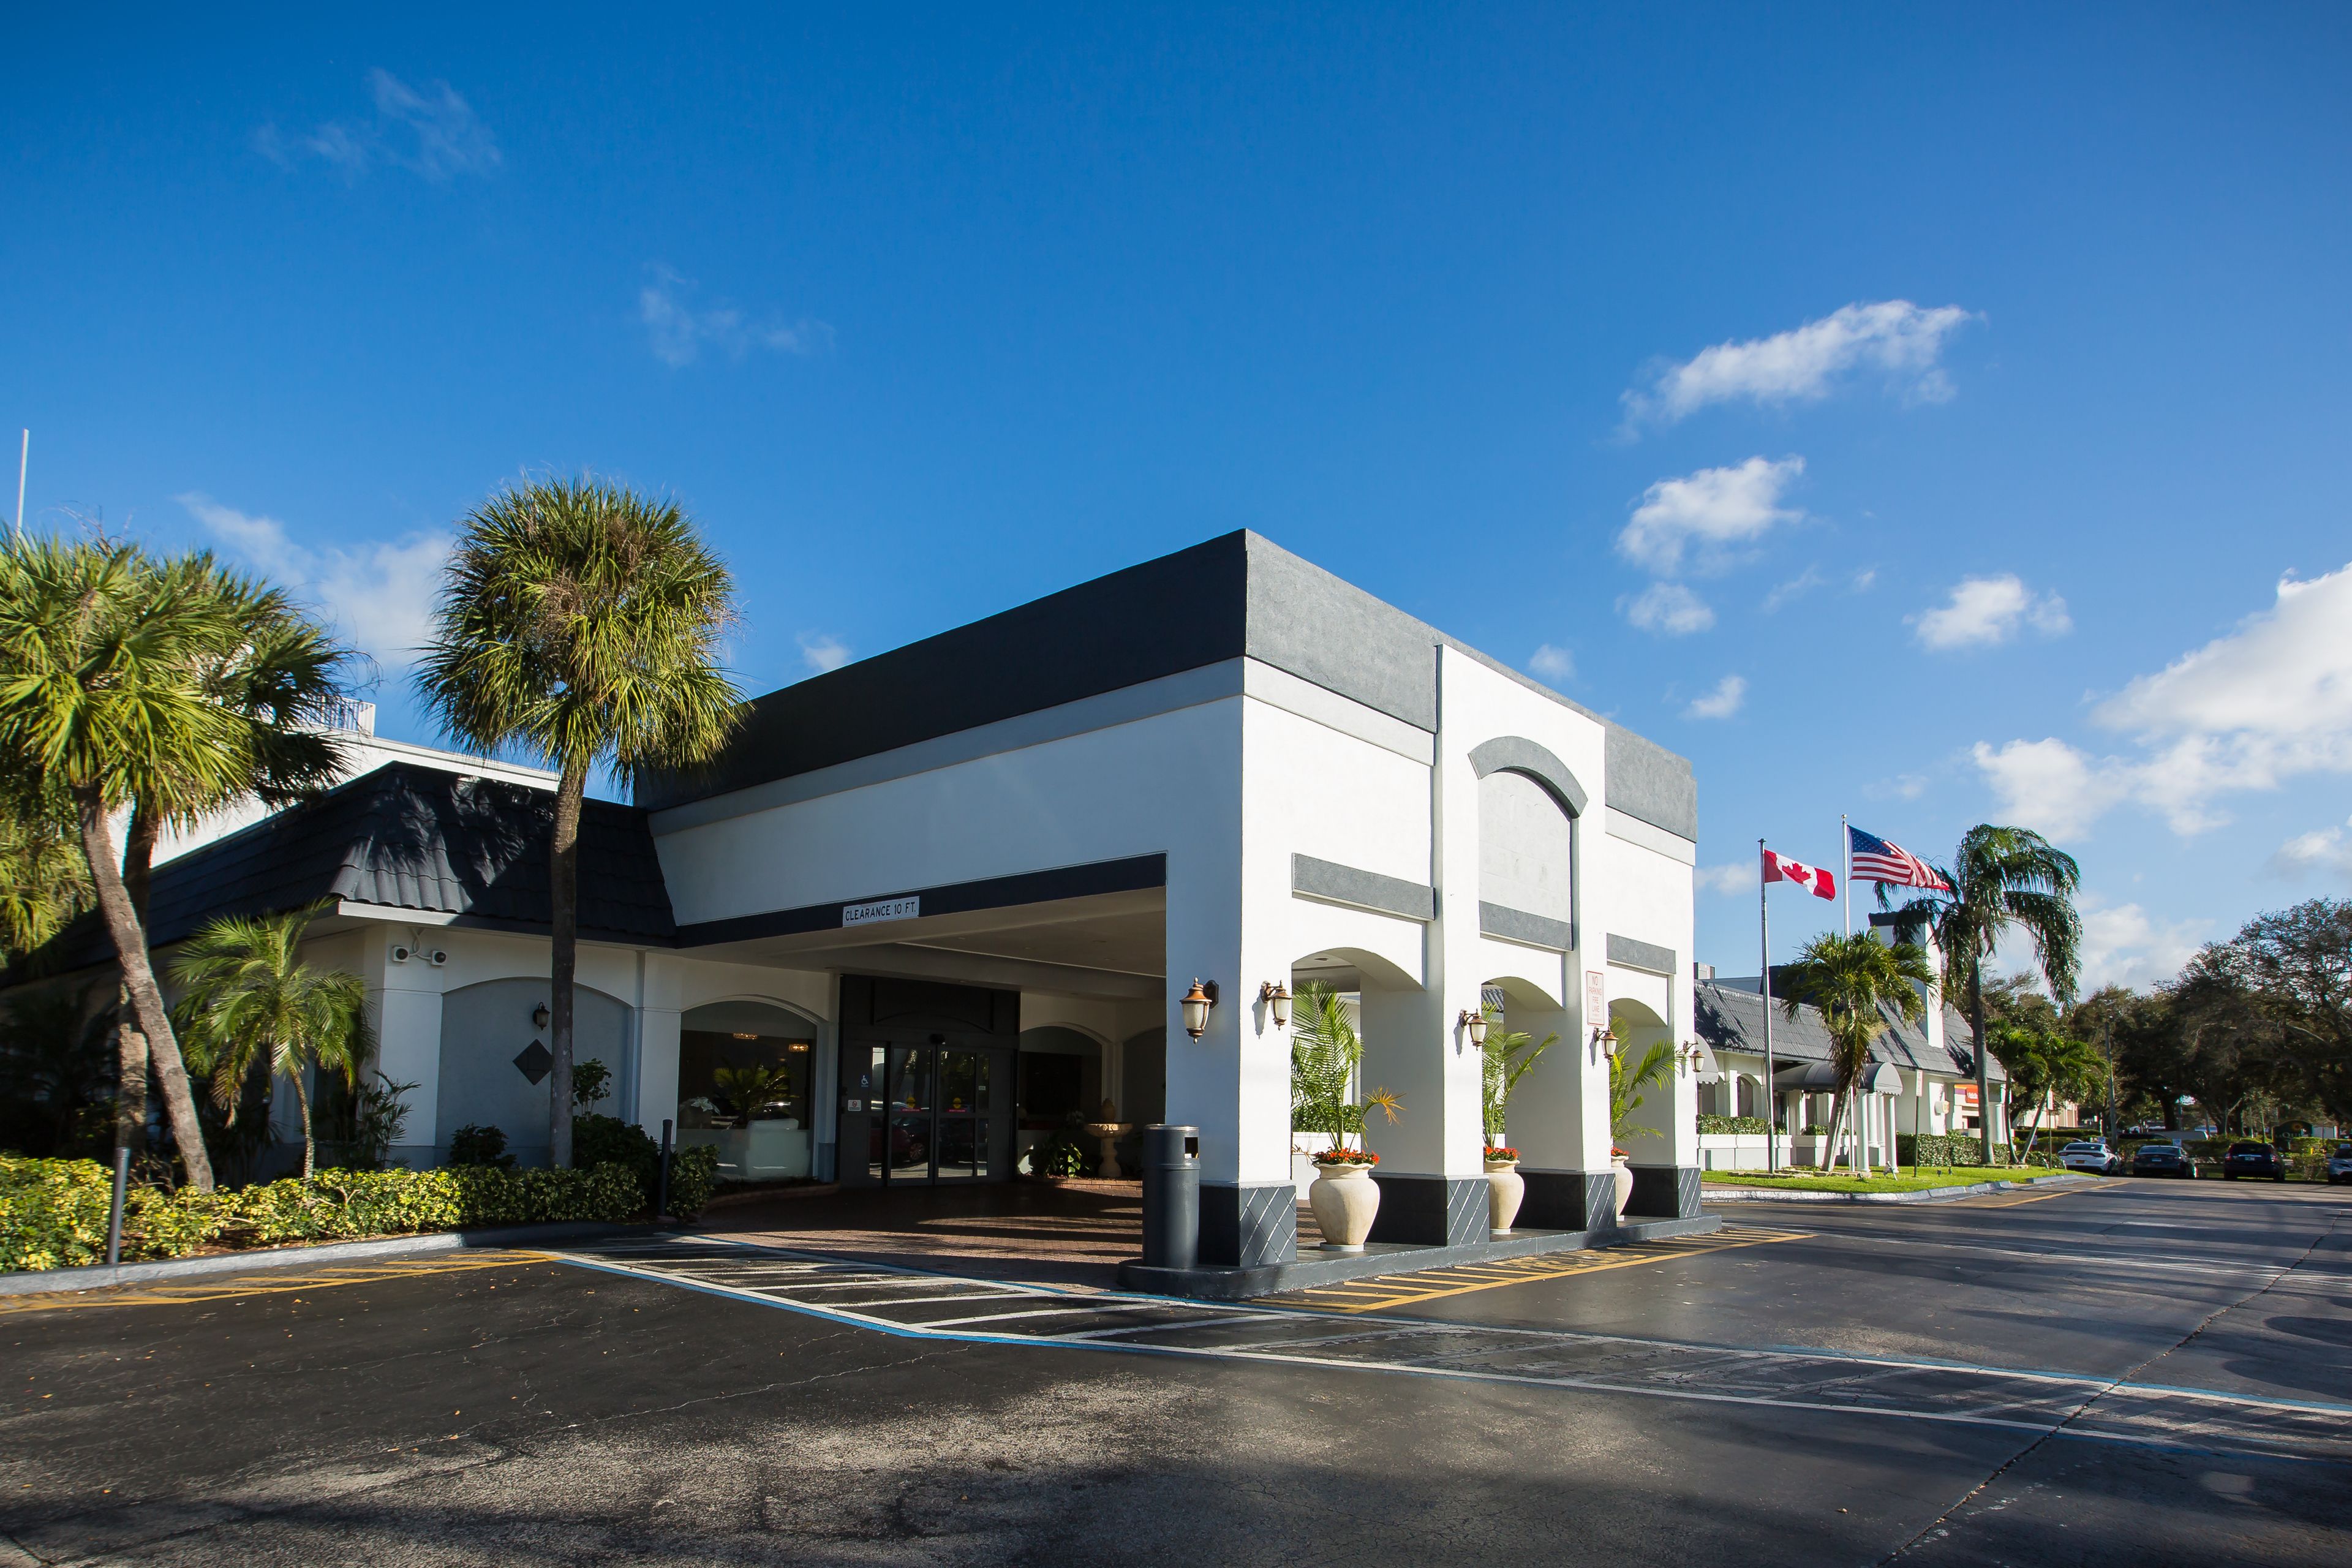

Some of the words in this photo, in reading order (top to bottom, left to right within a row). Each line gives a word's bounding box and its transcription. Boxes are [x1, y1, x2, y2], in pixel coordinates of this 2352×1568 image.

[845, 905, 891, 921] CLEARANCE
[894, 903, 902, 914] 10
[905, 902, 916, 913] FT.
[1593, 975, 1598, 986] NO
[1589, 986, 1602, 996] PARKING
